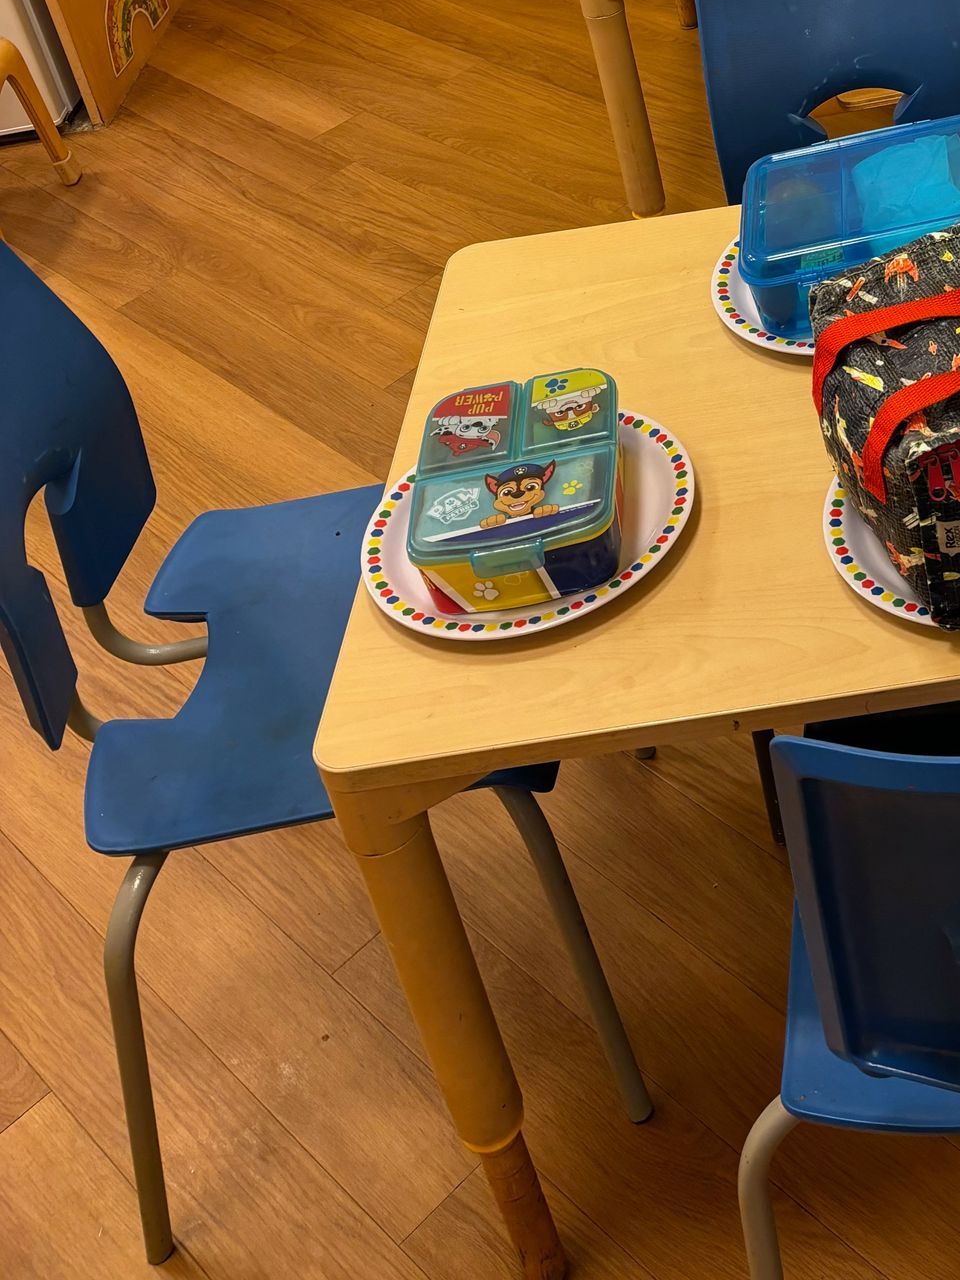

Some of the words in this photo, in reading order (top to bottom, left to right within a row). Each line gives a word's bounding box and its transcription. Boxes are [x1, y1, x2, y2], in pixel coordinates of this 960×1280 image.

[467, 402, 495, 415] PUP
[427, 487, 481, 519] PAW
[944, 527, 956, 549] Rex
